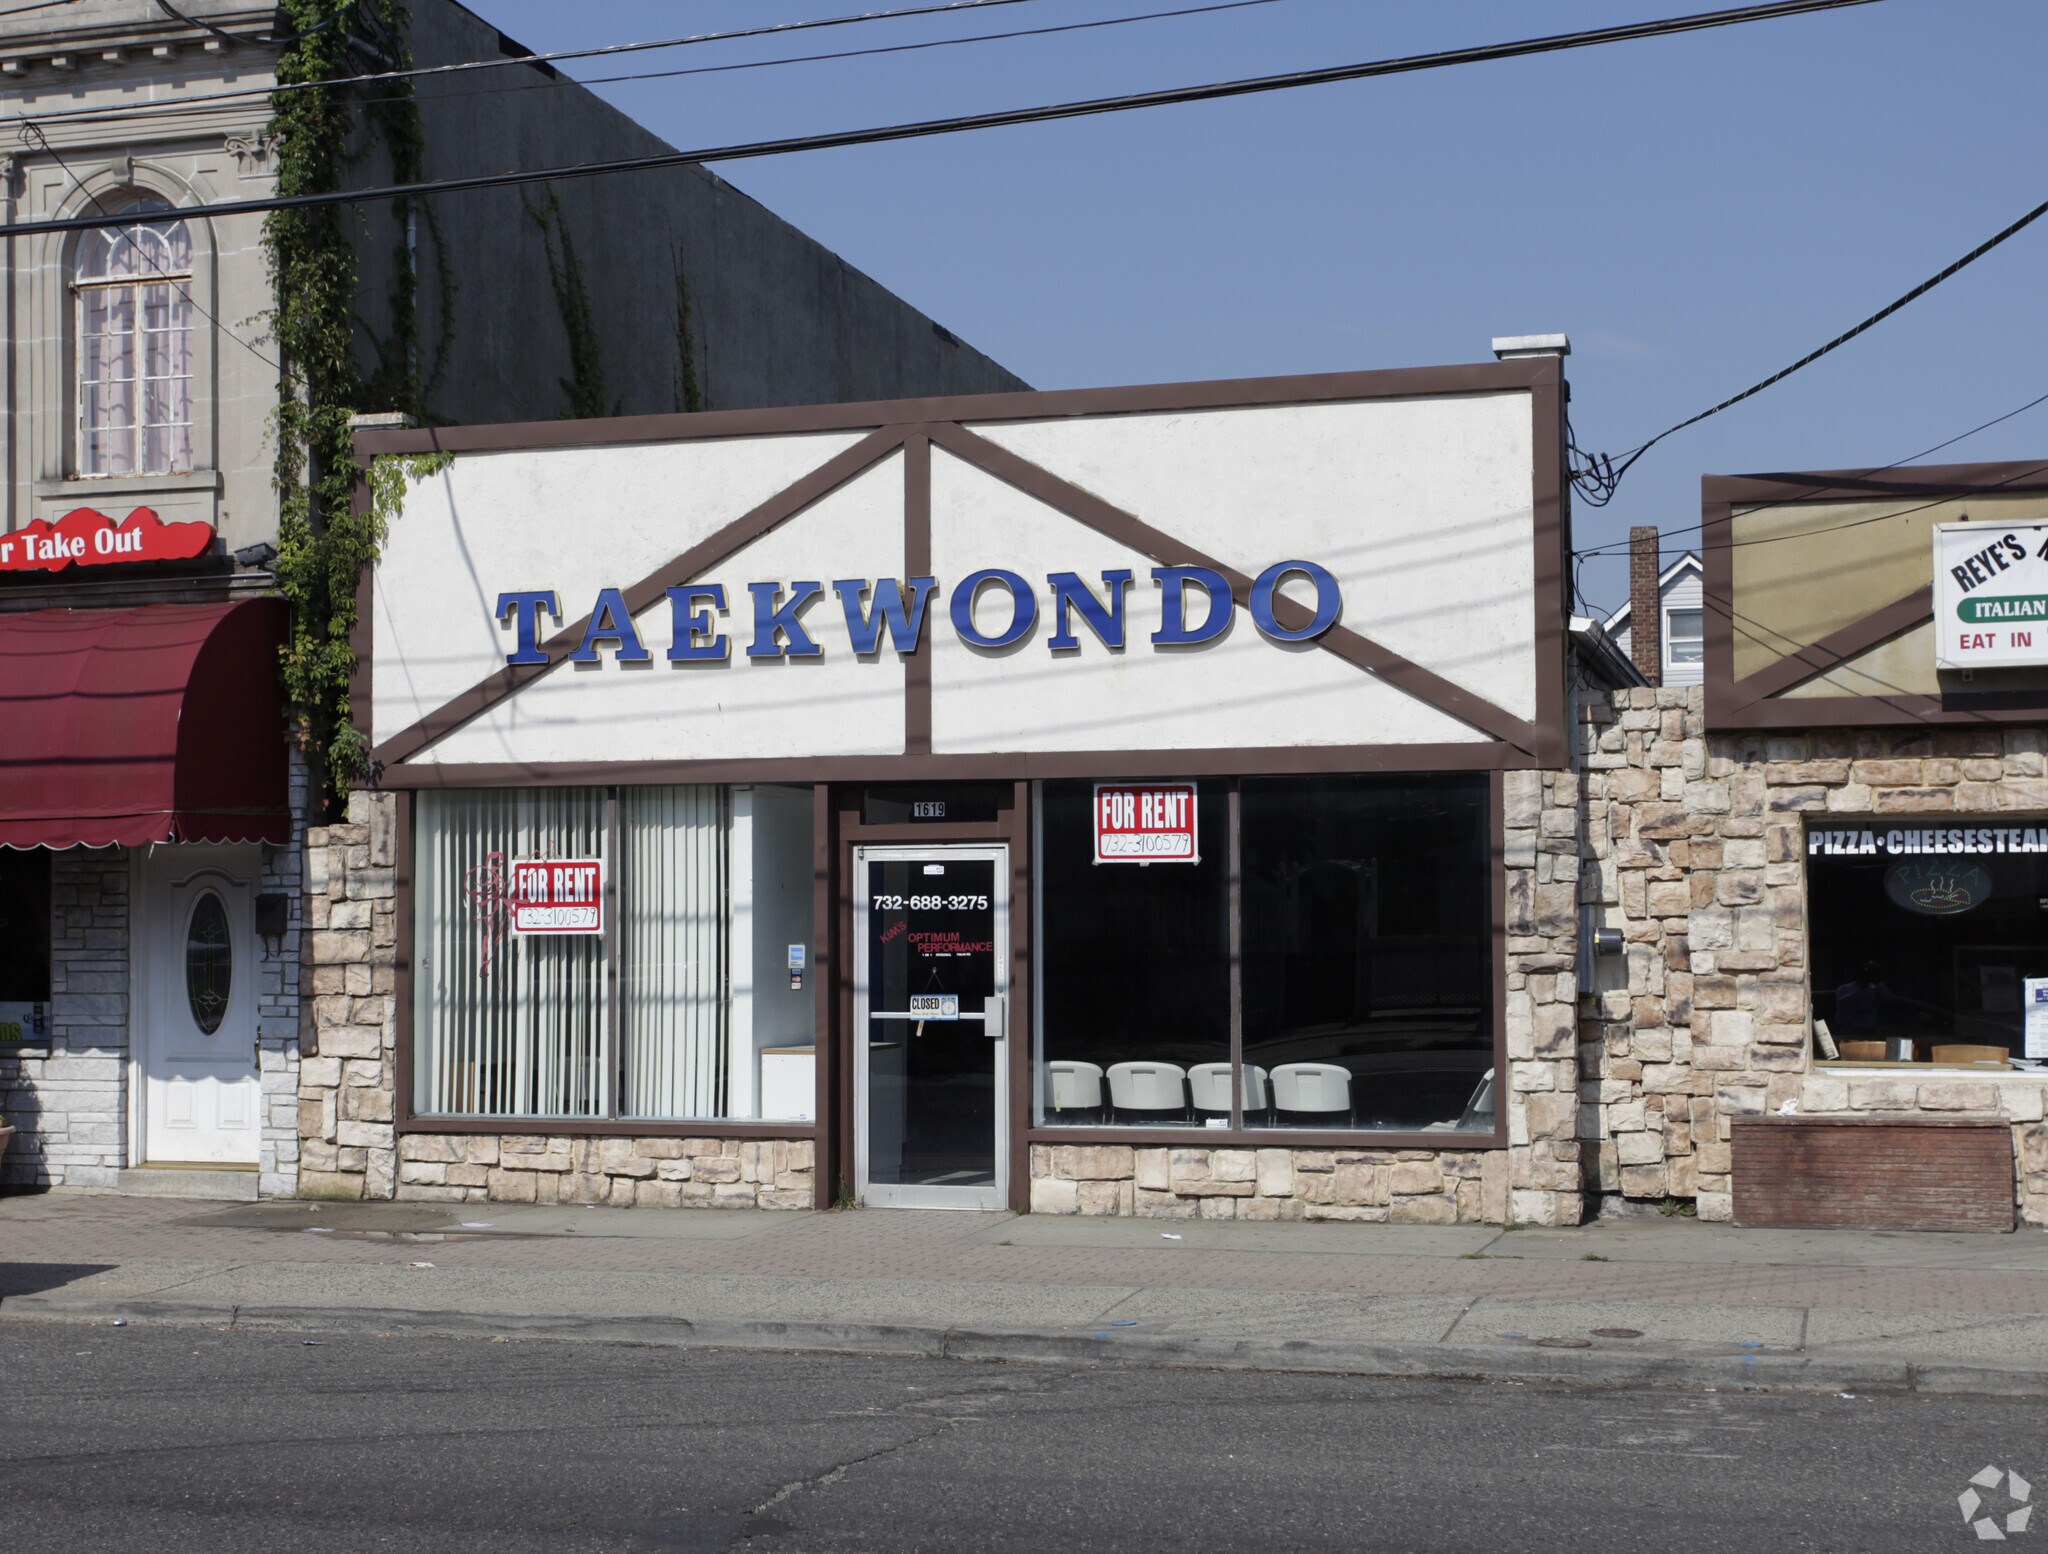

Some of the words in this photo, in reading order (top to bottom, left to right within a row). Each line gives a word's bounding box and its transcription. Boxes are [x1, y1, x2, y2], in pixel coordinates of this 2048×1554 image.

[0, 541, 14, 563] r
[21, 532, 86, 561] Take
[94, 526, 143, 555] Out
[1950, 533, 2027, 593] REYE'S
[495, 559, 1343, 664] TAEKWONDO
[1975, 600, 2047, 618] ITALIAN
[1960, 633, 1996, 650] EAT
[2011, 632, 2032, 648] IN
[915, 803, 945, 817] 1619
[1102, 792, 1136, 830] FOR
[1141, 791, 1189, 829] RENT
[1103, 834, 1190, 853] 732-3100579
[518, 868, 549, 904] FOR
[553, 867, 597, 903] RENT
[873, 895, 989, 911] 732-688-3275
[519, 907, 597, 926] 732-3100579
[880, 921, 907, 943] KIM'S
[908, 932, 960, 942] OPTIMUM
[918, 942, 993, 953] PERFORMANCE
[912, 997, 940, 1010] CLOSED
